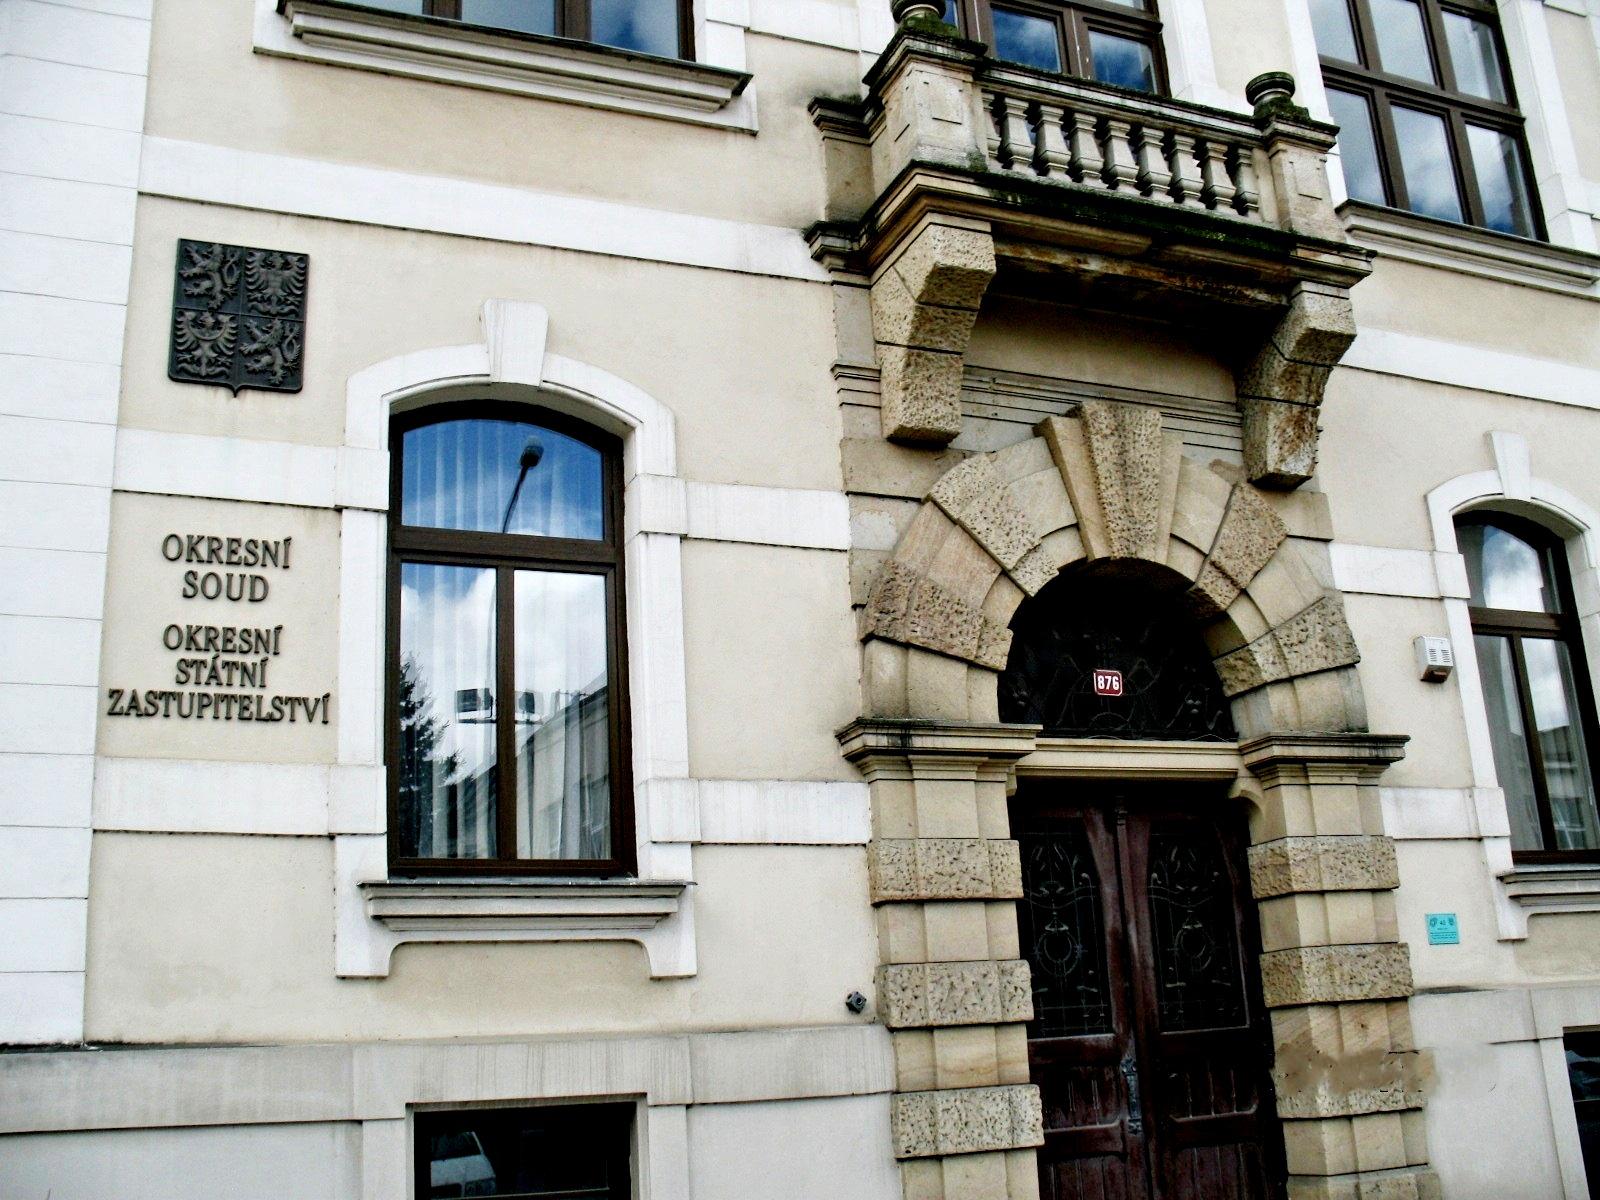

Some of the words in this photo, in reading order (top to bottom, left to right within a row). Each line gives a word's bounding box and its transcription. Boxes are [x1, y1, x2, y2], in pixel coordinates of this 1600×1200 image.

[162, 534, 292, 569] OKRESNÍ
[182, 570, 269, 602] SOUD
[163, 624, 283, 655] OKRESNÍ
[175, 654, 269, 688] STÁTNÍ
[1097, 675, 1119, 690] 876
[107, 688, 331, 724] ZASTUPITELSTVÍ
